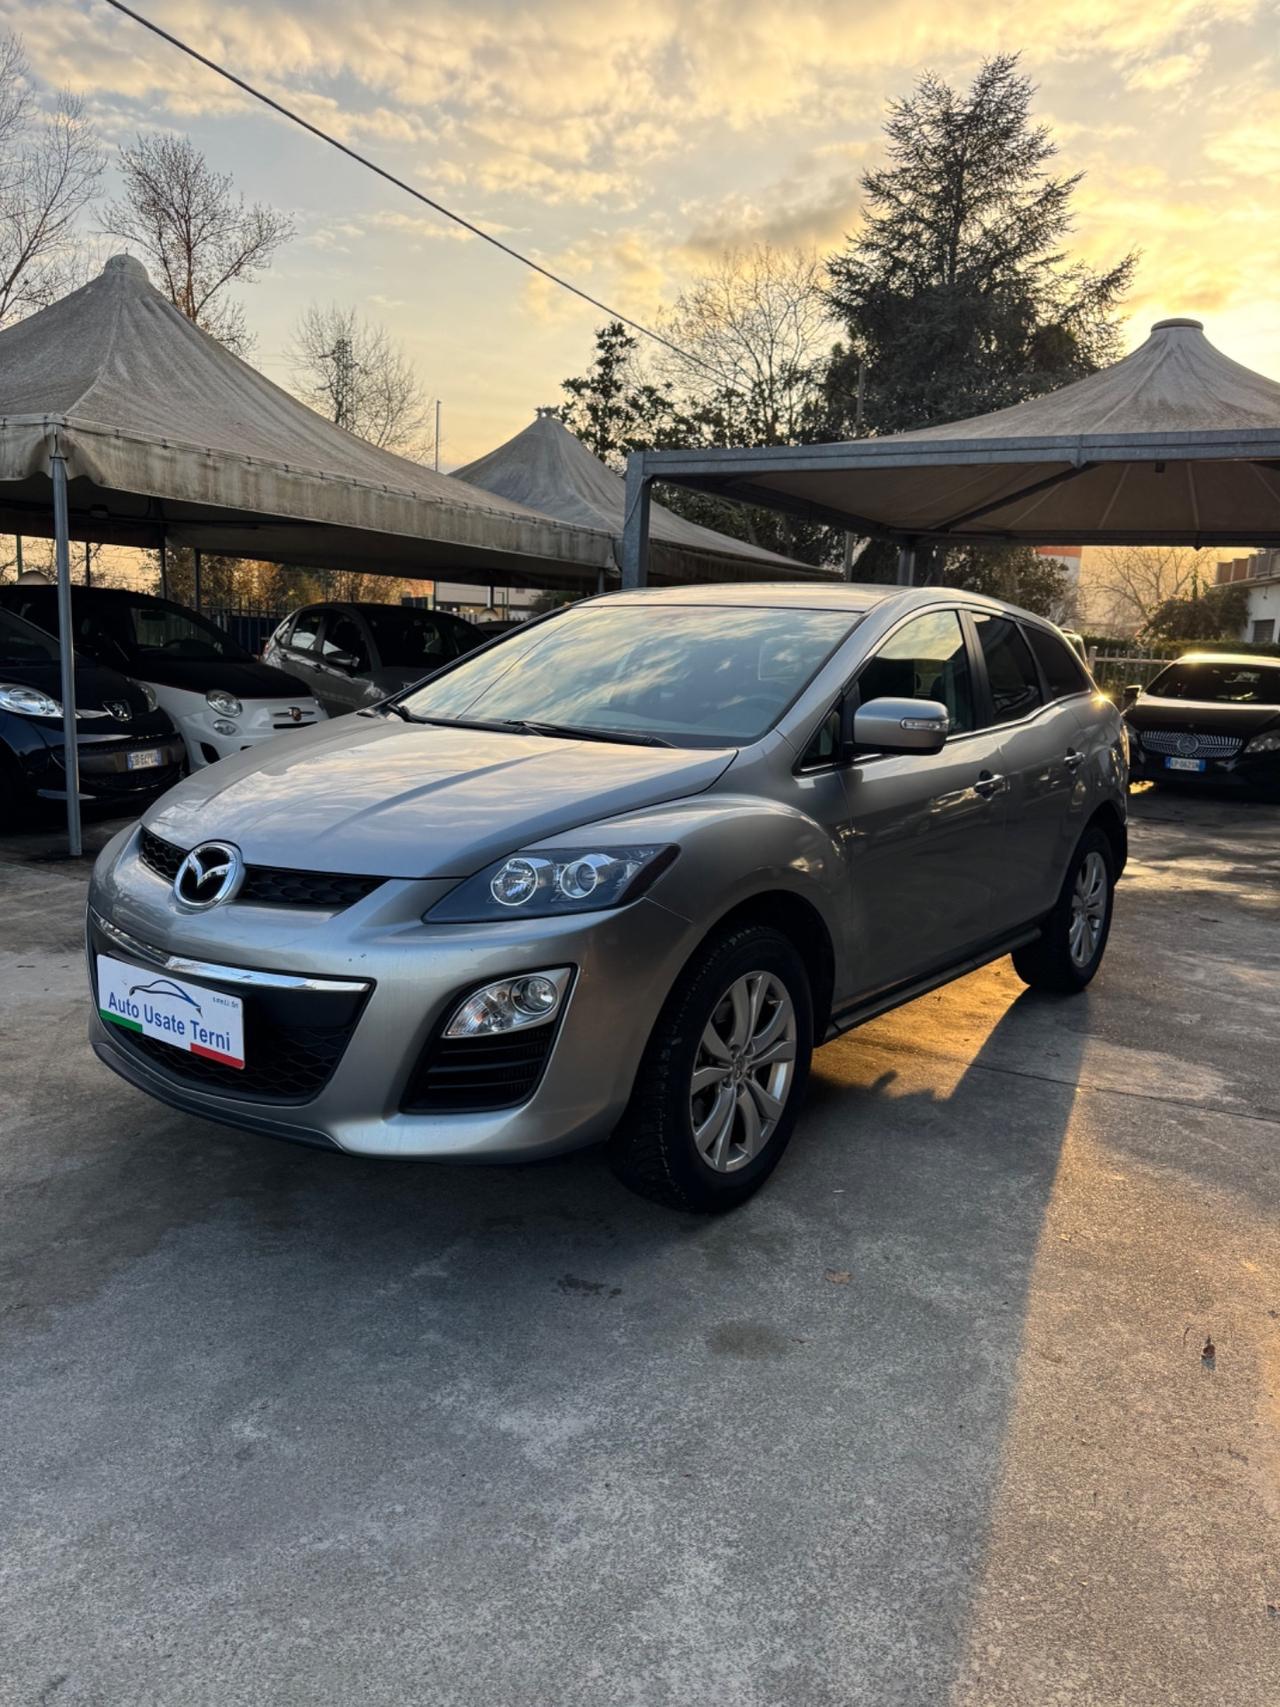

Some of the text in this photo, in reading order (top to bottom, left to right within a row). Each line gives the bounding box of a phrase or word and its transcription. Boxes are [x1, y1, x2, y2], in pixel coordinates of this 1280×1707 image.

[108, 992, 230, 1051] Auto Usate Terni
